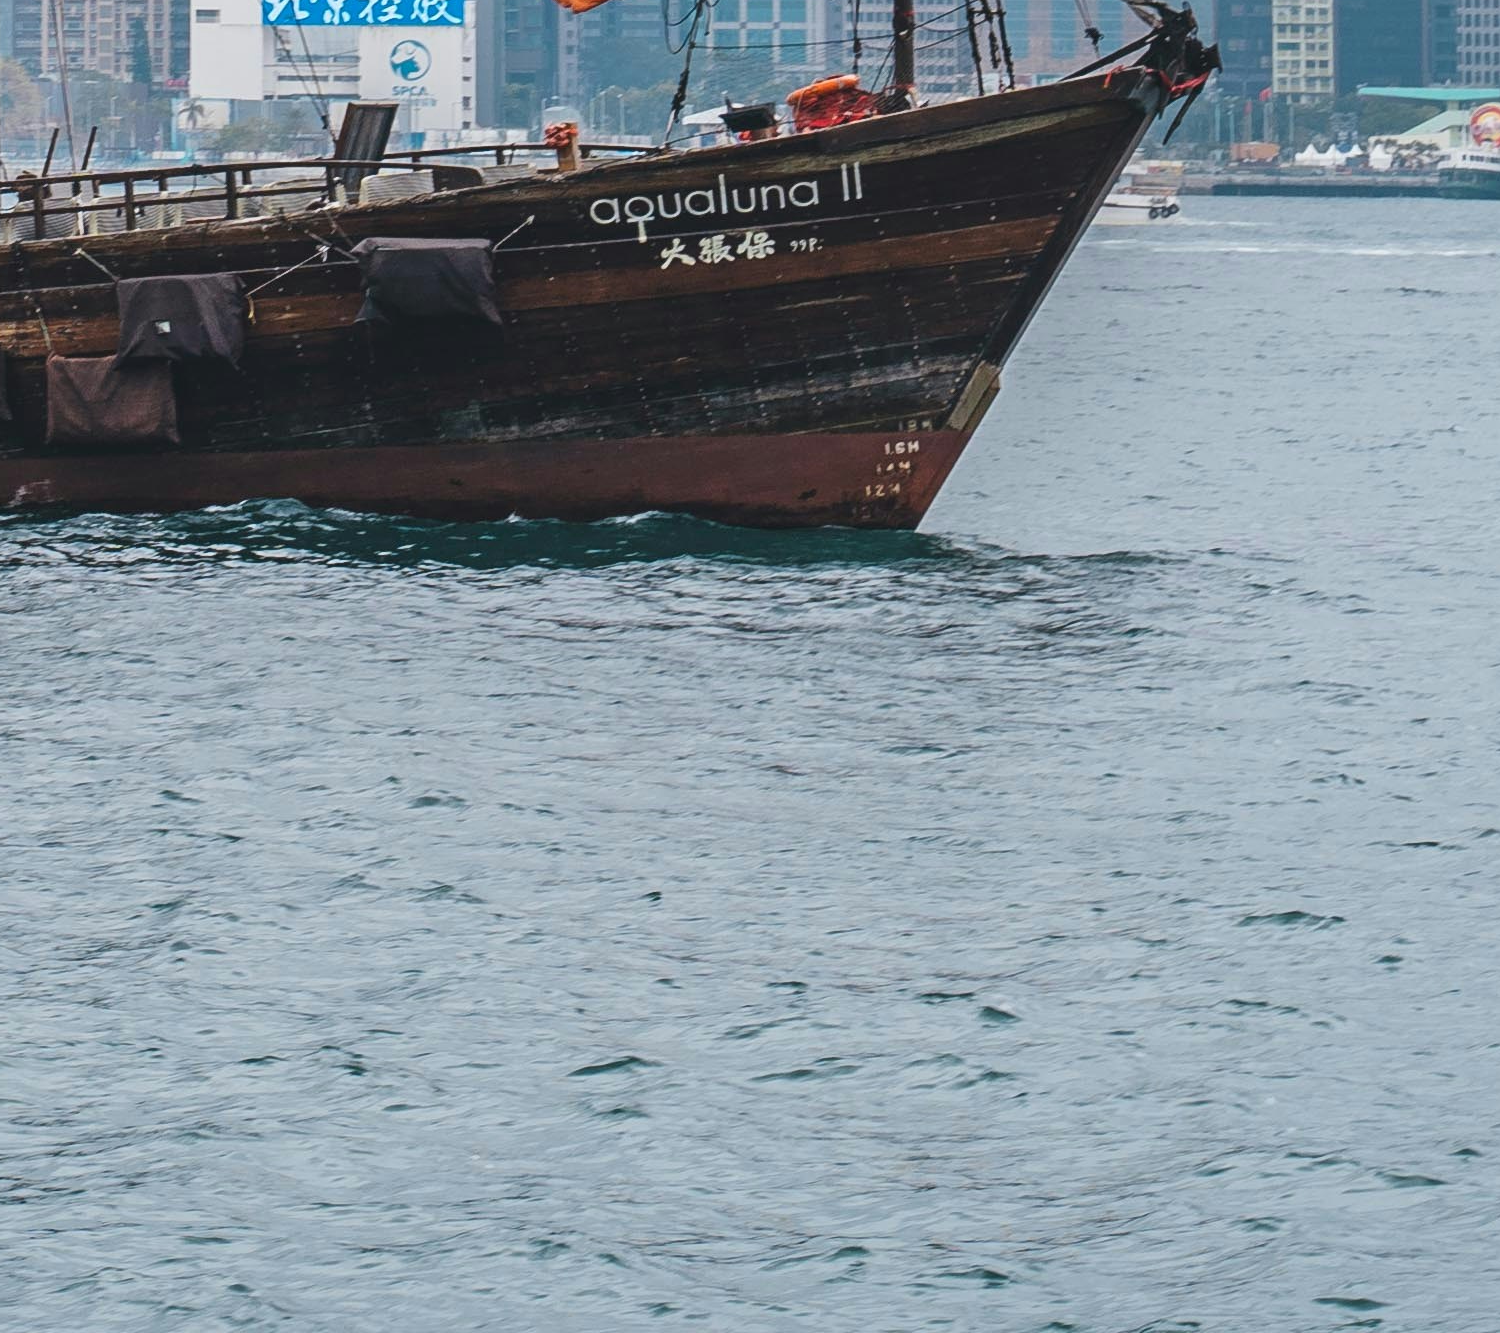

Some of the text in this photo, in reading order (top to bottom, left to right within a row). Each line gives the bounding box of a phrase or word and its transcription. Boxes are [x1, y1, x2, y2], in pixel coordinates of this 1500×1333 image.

[589, 173, 820, 244] aqualuna
[660, 231, 776, 271] 大張保
